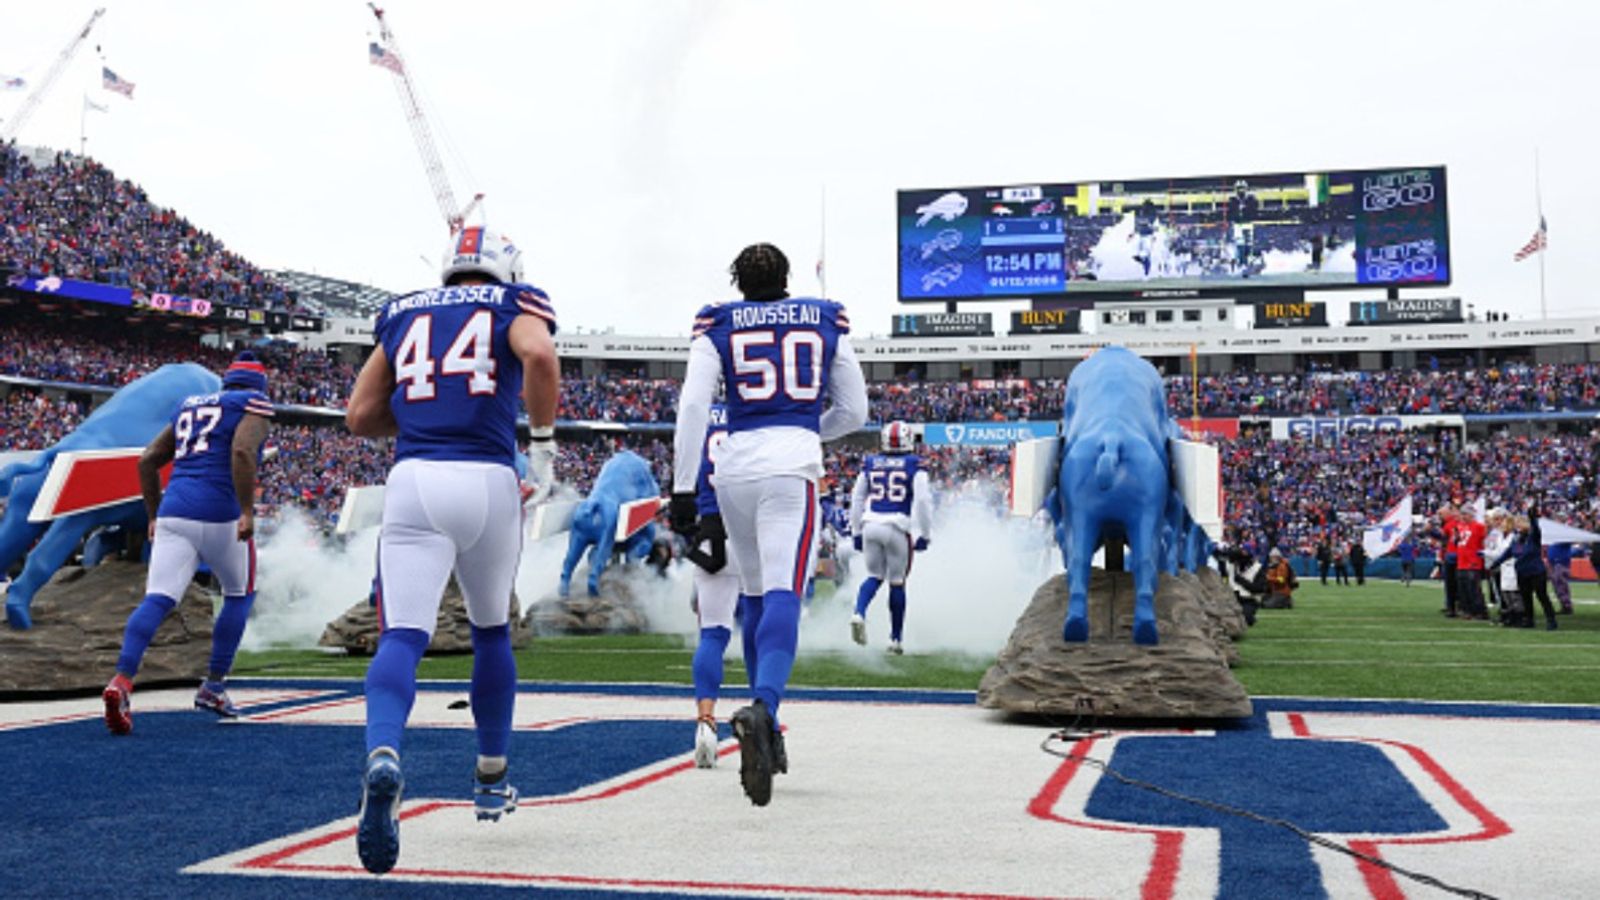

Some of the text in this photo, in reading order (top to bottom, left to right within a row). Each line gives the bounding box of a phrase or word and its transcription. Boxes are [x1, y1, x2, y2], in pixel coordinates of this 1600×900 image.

[986, 252, 1062, 273] 12:54 PM
[388, 285, 505, 318] ANDREESSEN
[1265, 303, 1313, 319] HUNT
[1387, 298, 1455, 313] IMAGINE
[732, 304, 821, 327] ROUSSEAU
[925, 314, 985, 325] IMAGINE
[1021, 310, 1066, 325] HUNT
[395, 310, 498, 402] 44
[730, 330, 825, 402] 50
[175, 406, 222, 459] 97
[869, 471, 907, 501] 56
